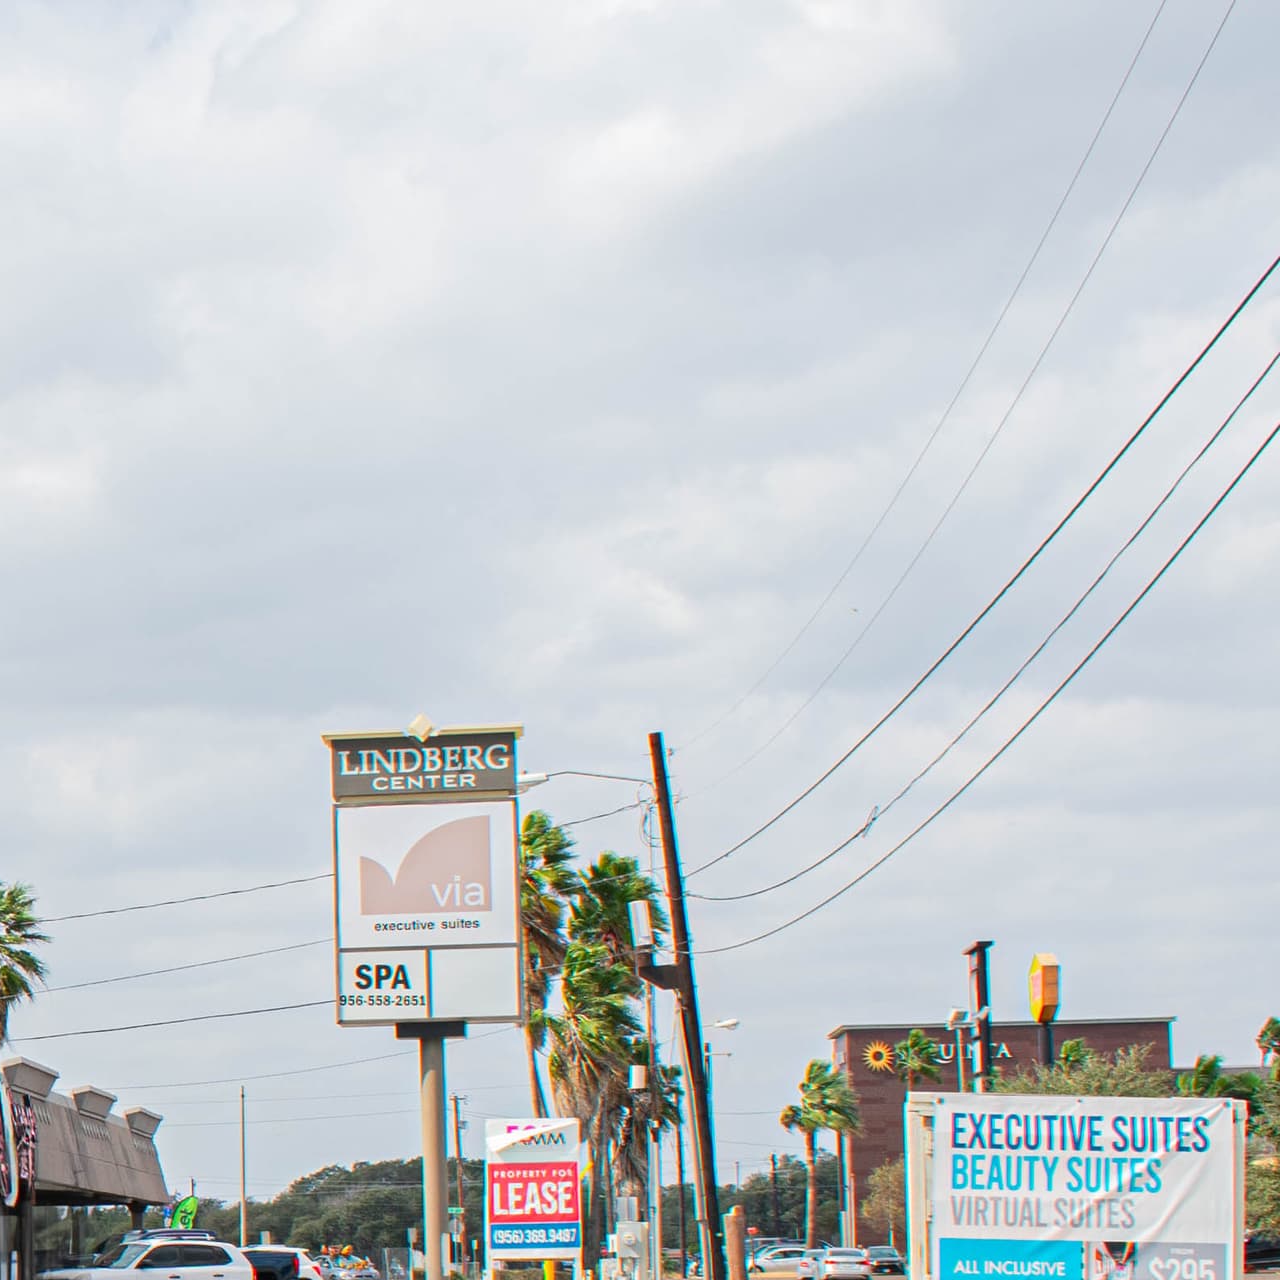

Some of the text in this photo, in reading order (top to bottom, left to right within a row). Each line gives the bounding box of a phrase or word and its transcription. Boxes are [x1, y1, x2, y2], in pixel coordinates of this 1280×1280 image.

[338, 744, 509, 775] LINDBERG
[371, 773, 477, 791] CENTER
[431, 874, 486, 908] via
[373, 917, 481, 932] executive suites
[354, 963, 412, 990] SPA
[340, 994, 427, 1008] 956-558-2651
[951, 1112, 1211, 1153] EXECUTIVE SUITES
[493, 1168, 573, 1179] PROPERTY FOR
[951, 1154, 1163, 1194] BEAUTY SUITES
[493, 1181, 574, 1216] LEASE
[951, 1195, 1136, 1229] VIRTUAL SUITES
[953, 1259, 1067, 1277] ALL INCLUSIVE
